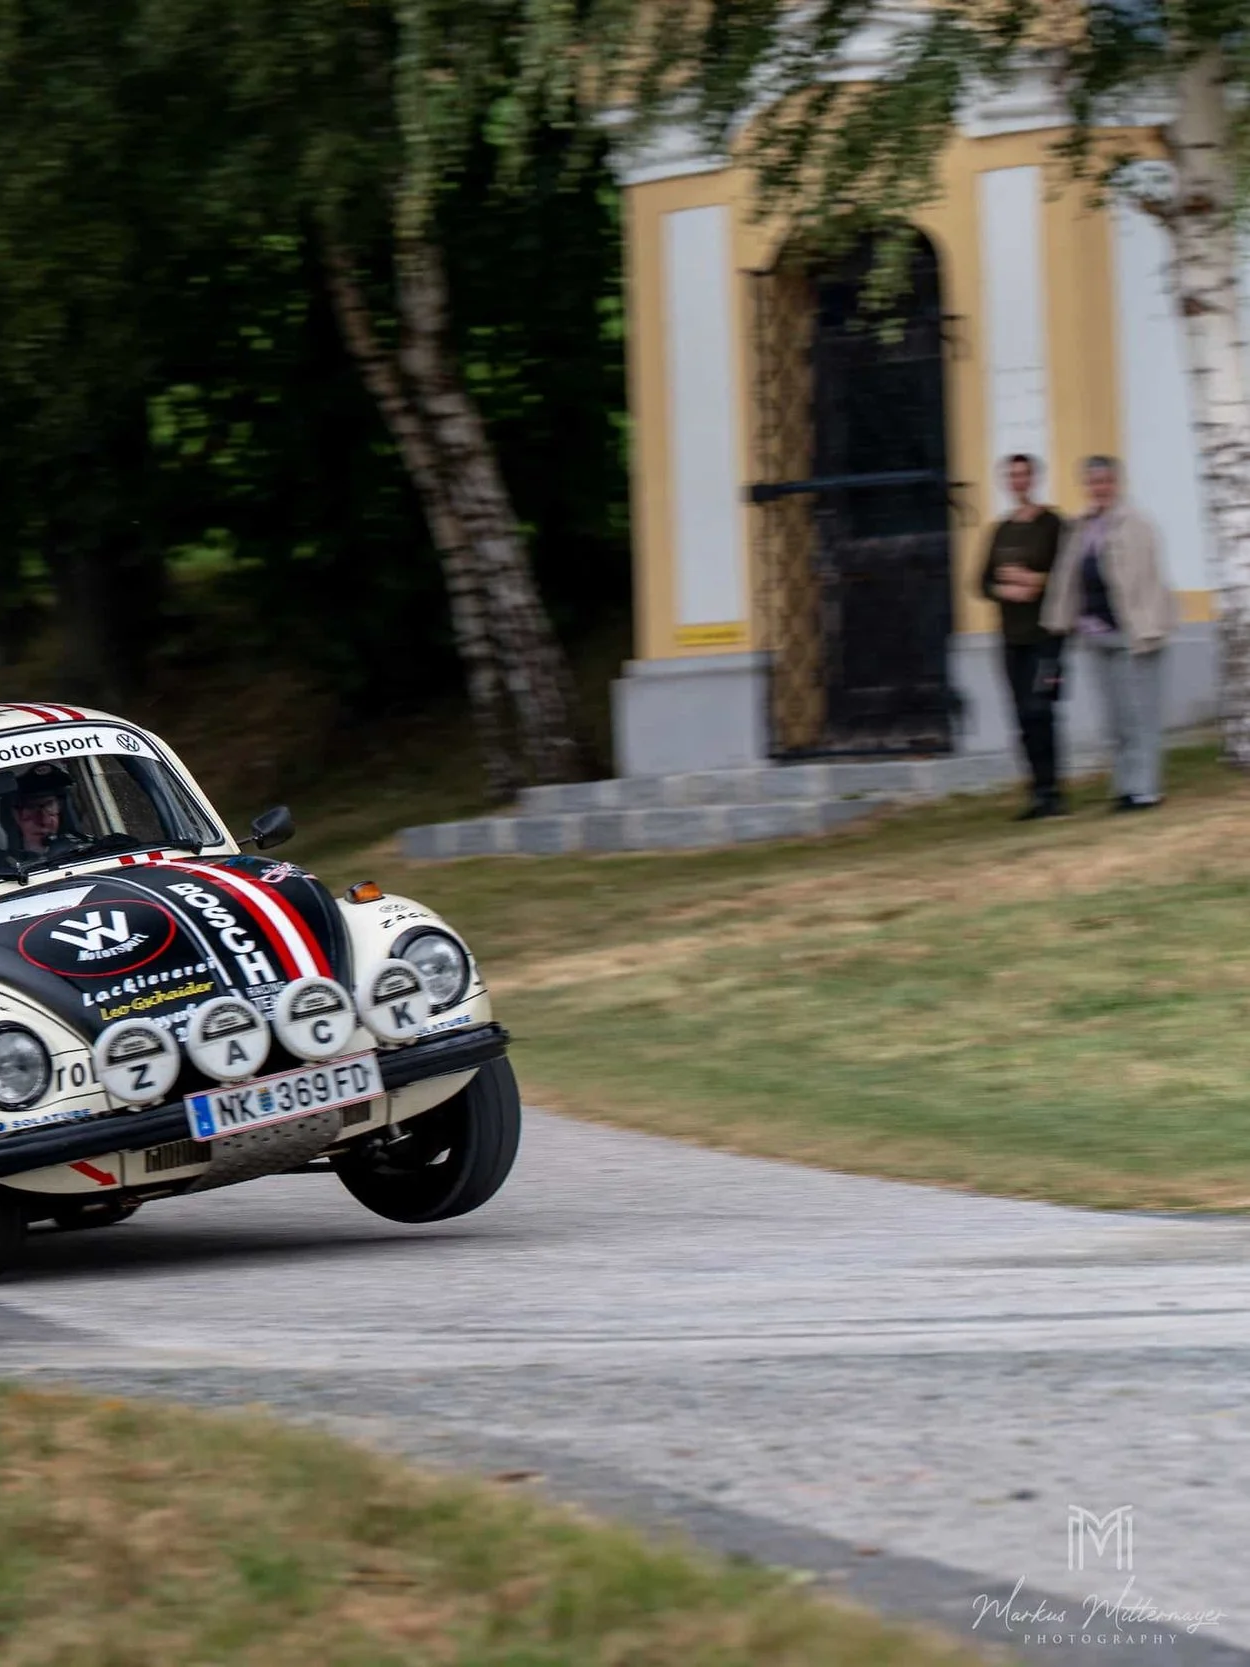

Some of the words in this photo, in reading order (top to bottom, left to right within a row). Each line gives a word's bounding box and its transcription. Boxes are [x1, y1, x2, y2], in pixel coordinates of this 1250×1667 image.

[167, 882, 277, 985] BOSCH
[128, 1062, 156, 1091] Z
[226, 1040, 250, 1066] A
[313, 1019, 333, 1044] C
[390, 1002, 415, 1029] K
[215, 1090, 257, 1127] NK
